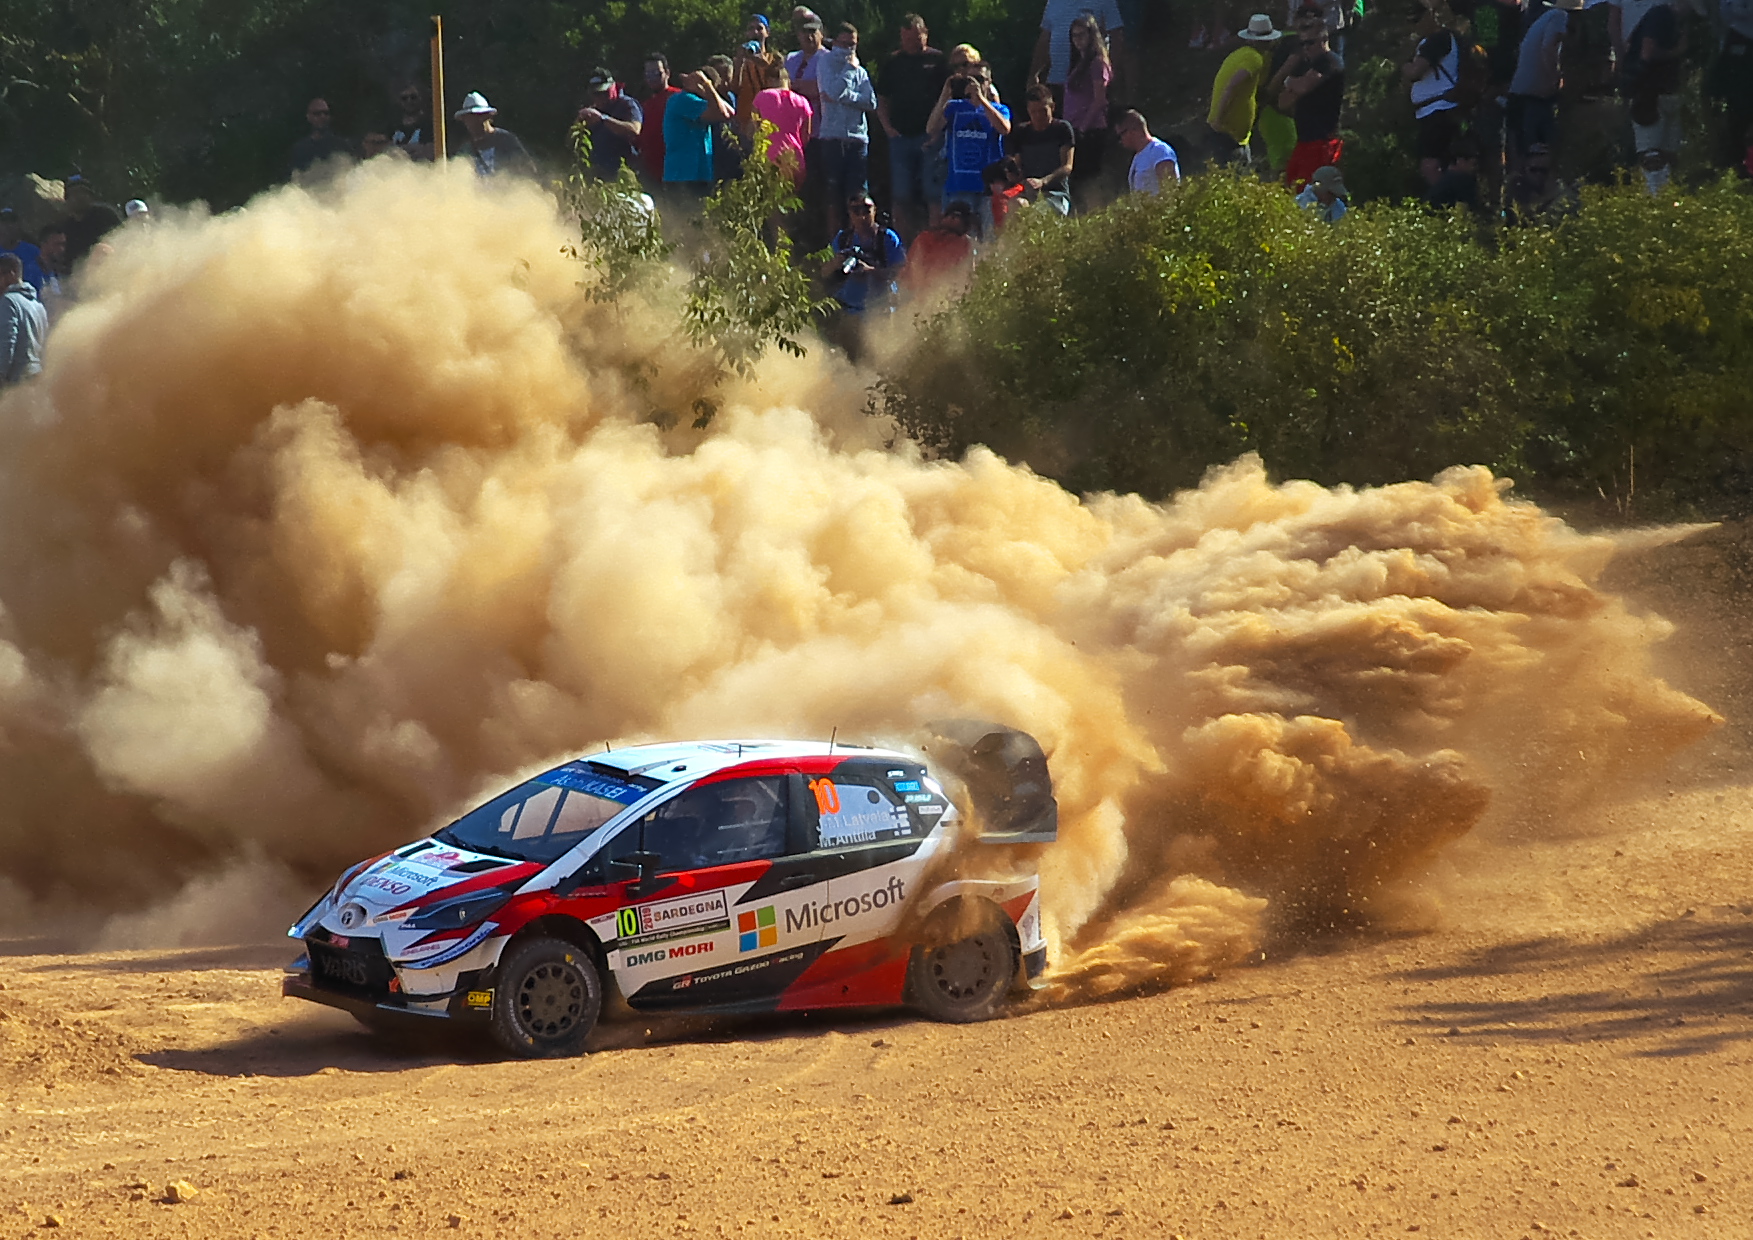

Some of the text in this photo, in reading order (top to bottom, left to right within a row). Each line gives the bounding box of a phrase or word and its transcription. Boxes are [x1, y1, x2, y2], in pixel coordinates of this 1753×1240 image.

[956, 130, 988, 139] adidas
[808, 778, 841, 815] 10
[653, 899, 723, 922] SARDEGNA
[785, 876, 905, 933] Microsoft
[617, 908, 637, 938] 10
[642, 907, 653, 930] 2019
[626, 941, 714, 968] DMG MORI
[467, 994, 491, 1004] OMP
